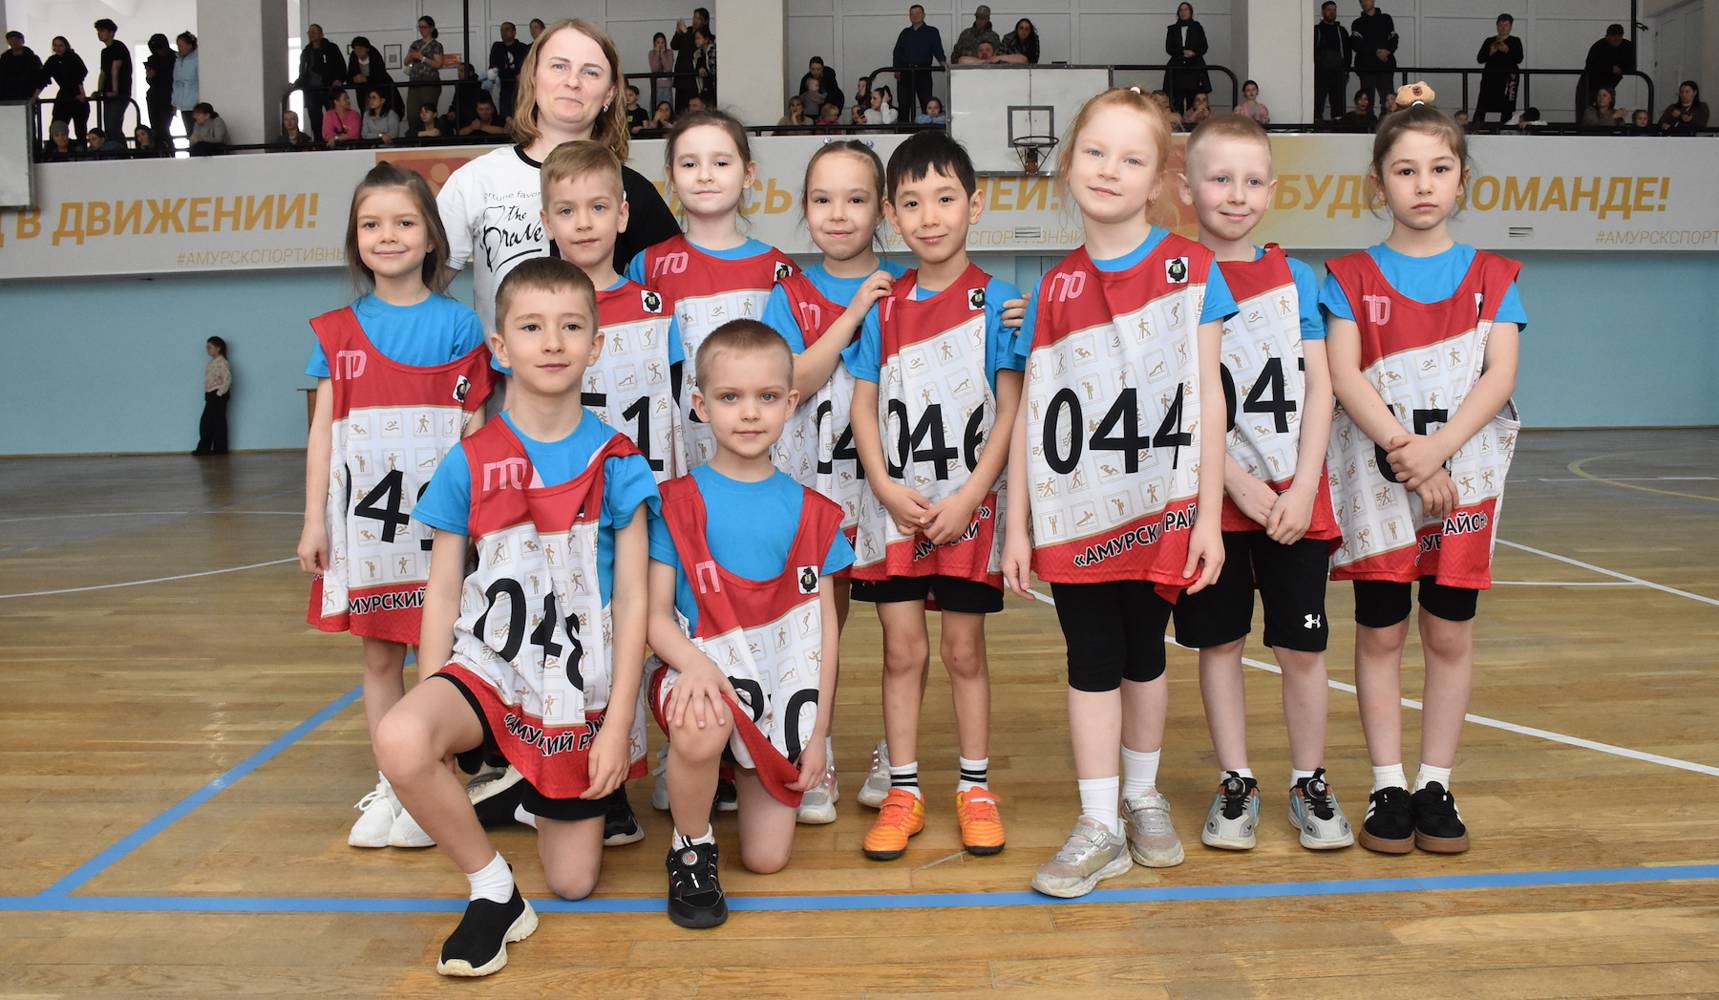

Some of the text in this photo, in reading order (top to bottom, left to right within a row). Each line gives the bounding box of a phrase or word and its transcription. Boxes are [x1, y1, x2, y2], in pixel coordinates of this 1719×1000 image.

[52, 192, 319, 246] ДВИЖЕНИИ!
[517, 189, 542, 199] favor
[1456, 175, 1671, 220] ОМАНДЕ!
[176, 248, 345, 266] #АМУРСКСПОРТИВНЫ
[1219, 356, 1306, 434] 04
[887, 398, 985, 482] 046
[1042, 382, 1192, 475] 044
[1073, 503, 1198, 568] «АМУРСК РАЙ
[348, 586, 427, 616] МУРСКИЙ
